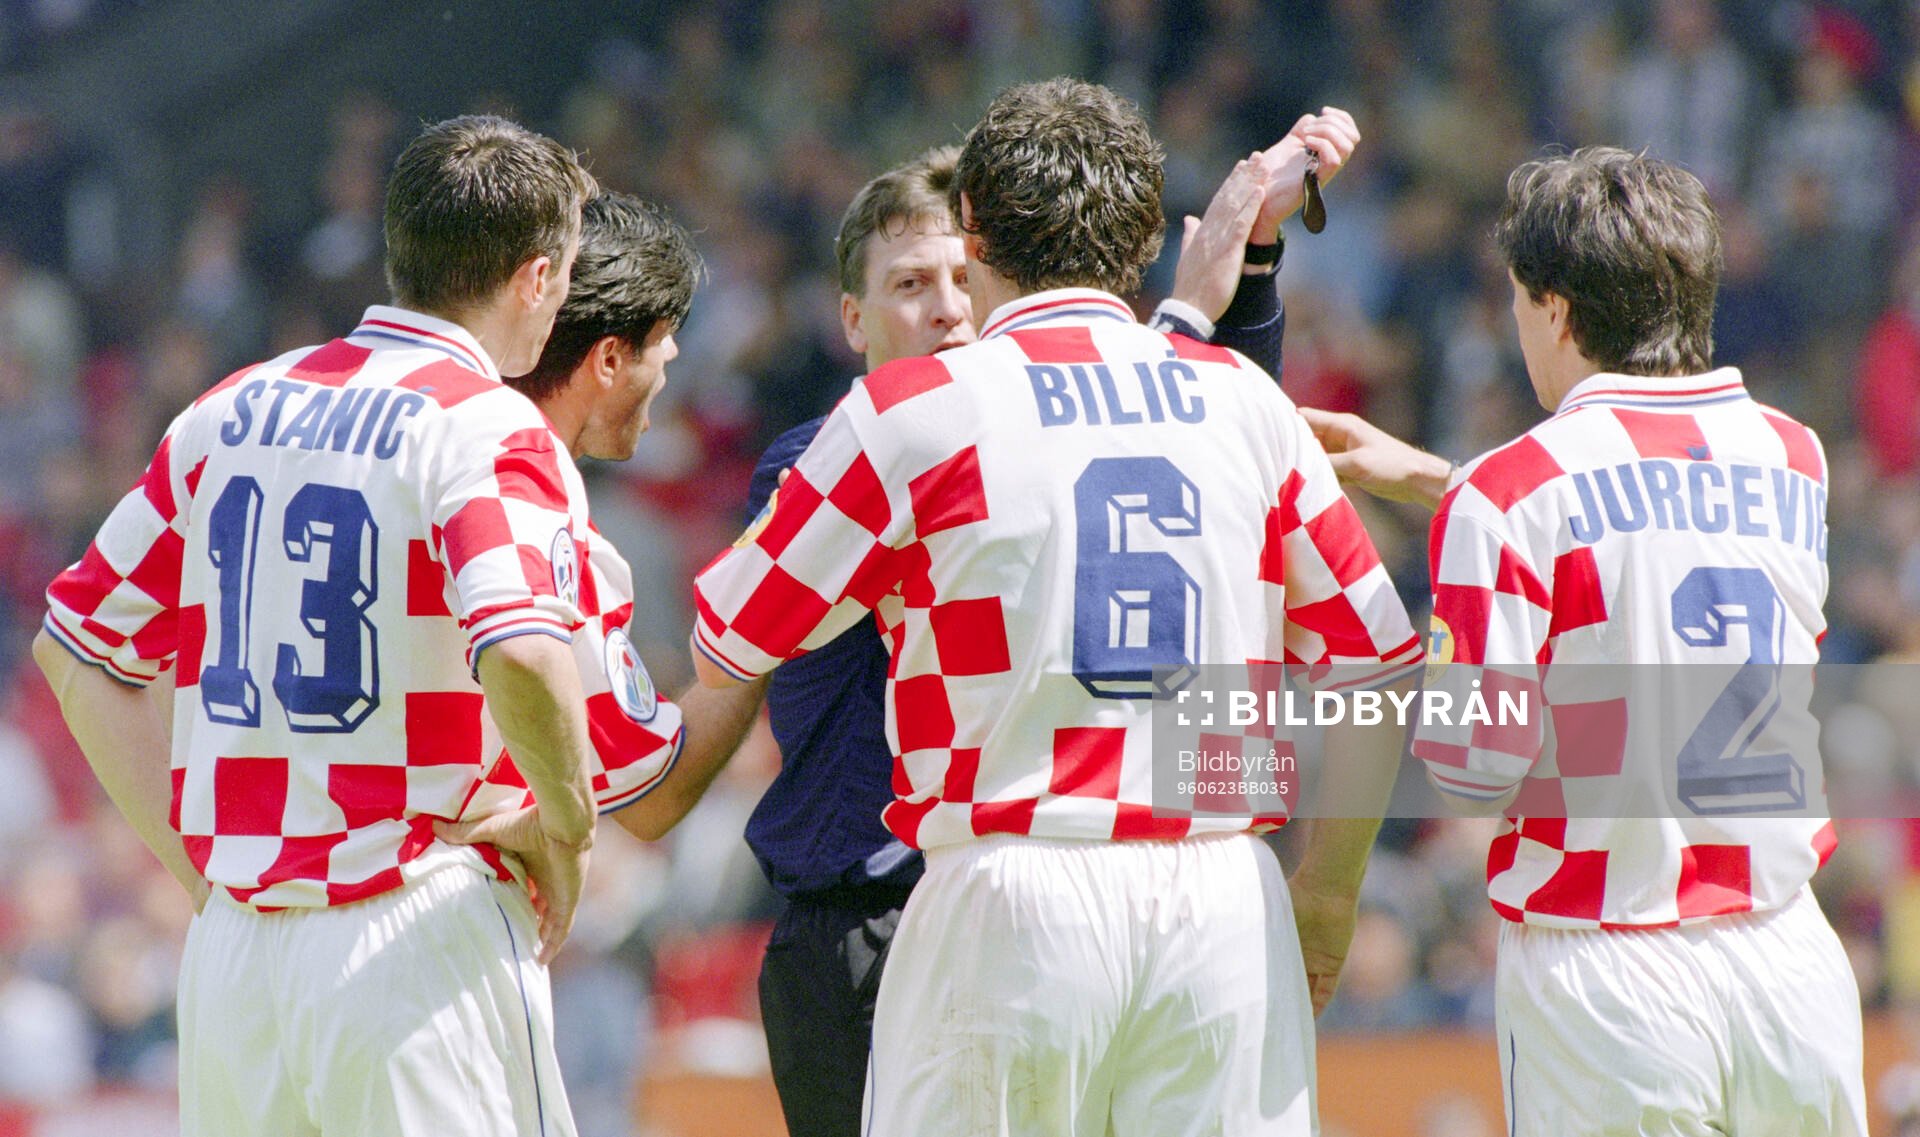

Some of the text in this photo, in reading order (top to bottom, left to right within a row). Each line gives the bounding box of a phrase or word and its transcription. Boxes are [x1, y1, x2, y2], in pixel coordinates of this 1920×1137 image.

[220, 379, 436, 460] STANIĆ
[1024, 350, 1206, 427] BILIĆ
[200, 475, 380, 733] 13
[1072, 456, 1202, 700] 6
[1671, 567, 1806, 815] 2
